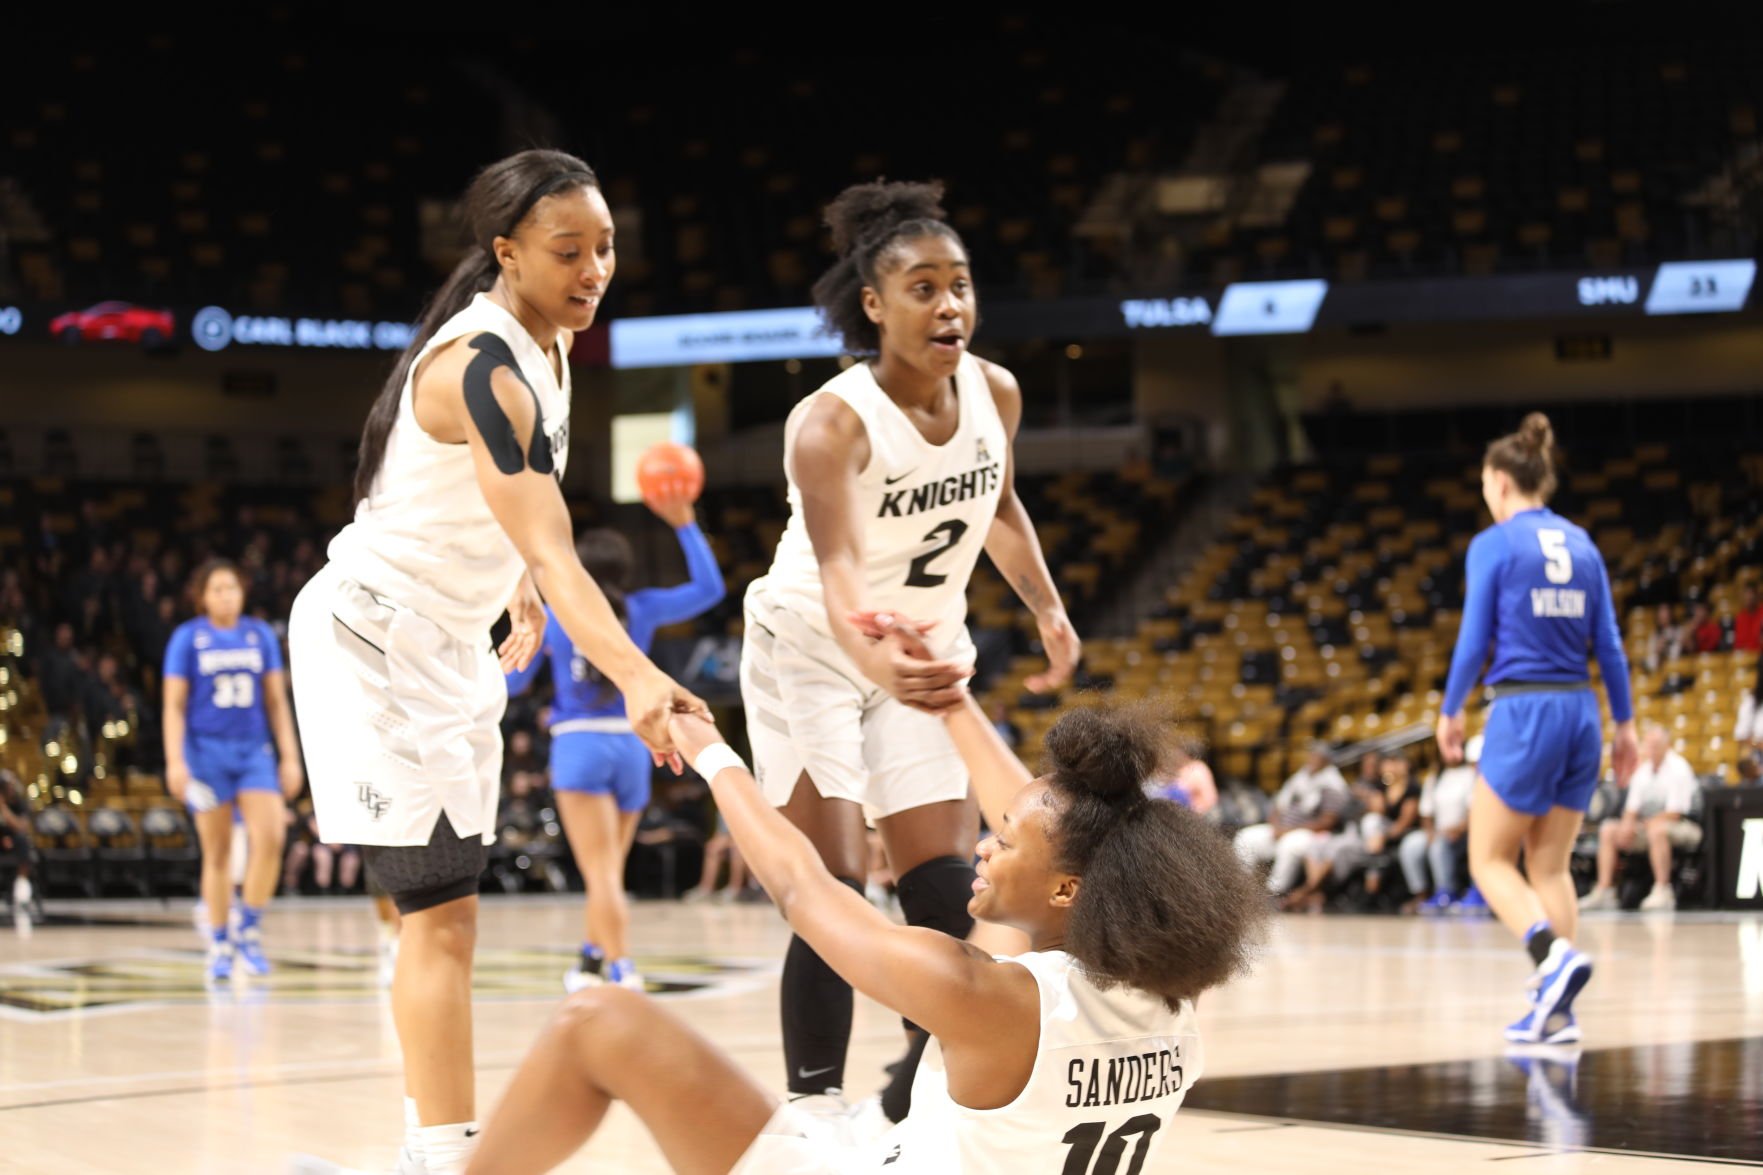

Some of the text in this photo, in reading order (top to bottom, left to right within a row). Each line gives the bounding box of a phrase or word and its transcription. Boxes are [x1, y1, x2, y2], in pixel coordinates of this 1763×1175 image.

[1577, 275, 1639, 305] SMU
[232, 315, 294, 345] CARL
[295, 318, 372, 348] BLACK
[1121, 297, 1212, 328] TULSA
[877, 462, 999, 518] KNIGHTS
[903, 518, 969, 588] 2
[1536, 530, 1573, 585] 5
[1530, 587, 1586, 618] WILSON
[213, 672, 254, 709] 33
[354, 781, 392, 822] UCF
[1065, 1045, 1184, 1108] SANDERS
[1061, 1112, 1162, 1175] 10
